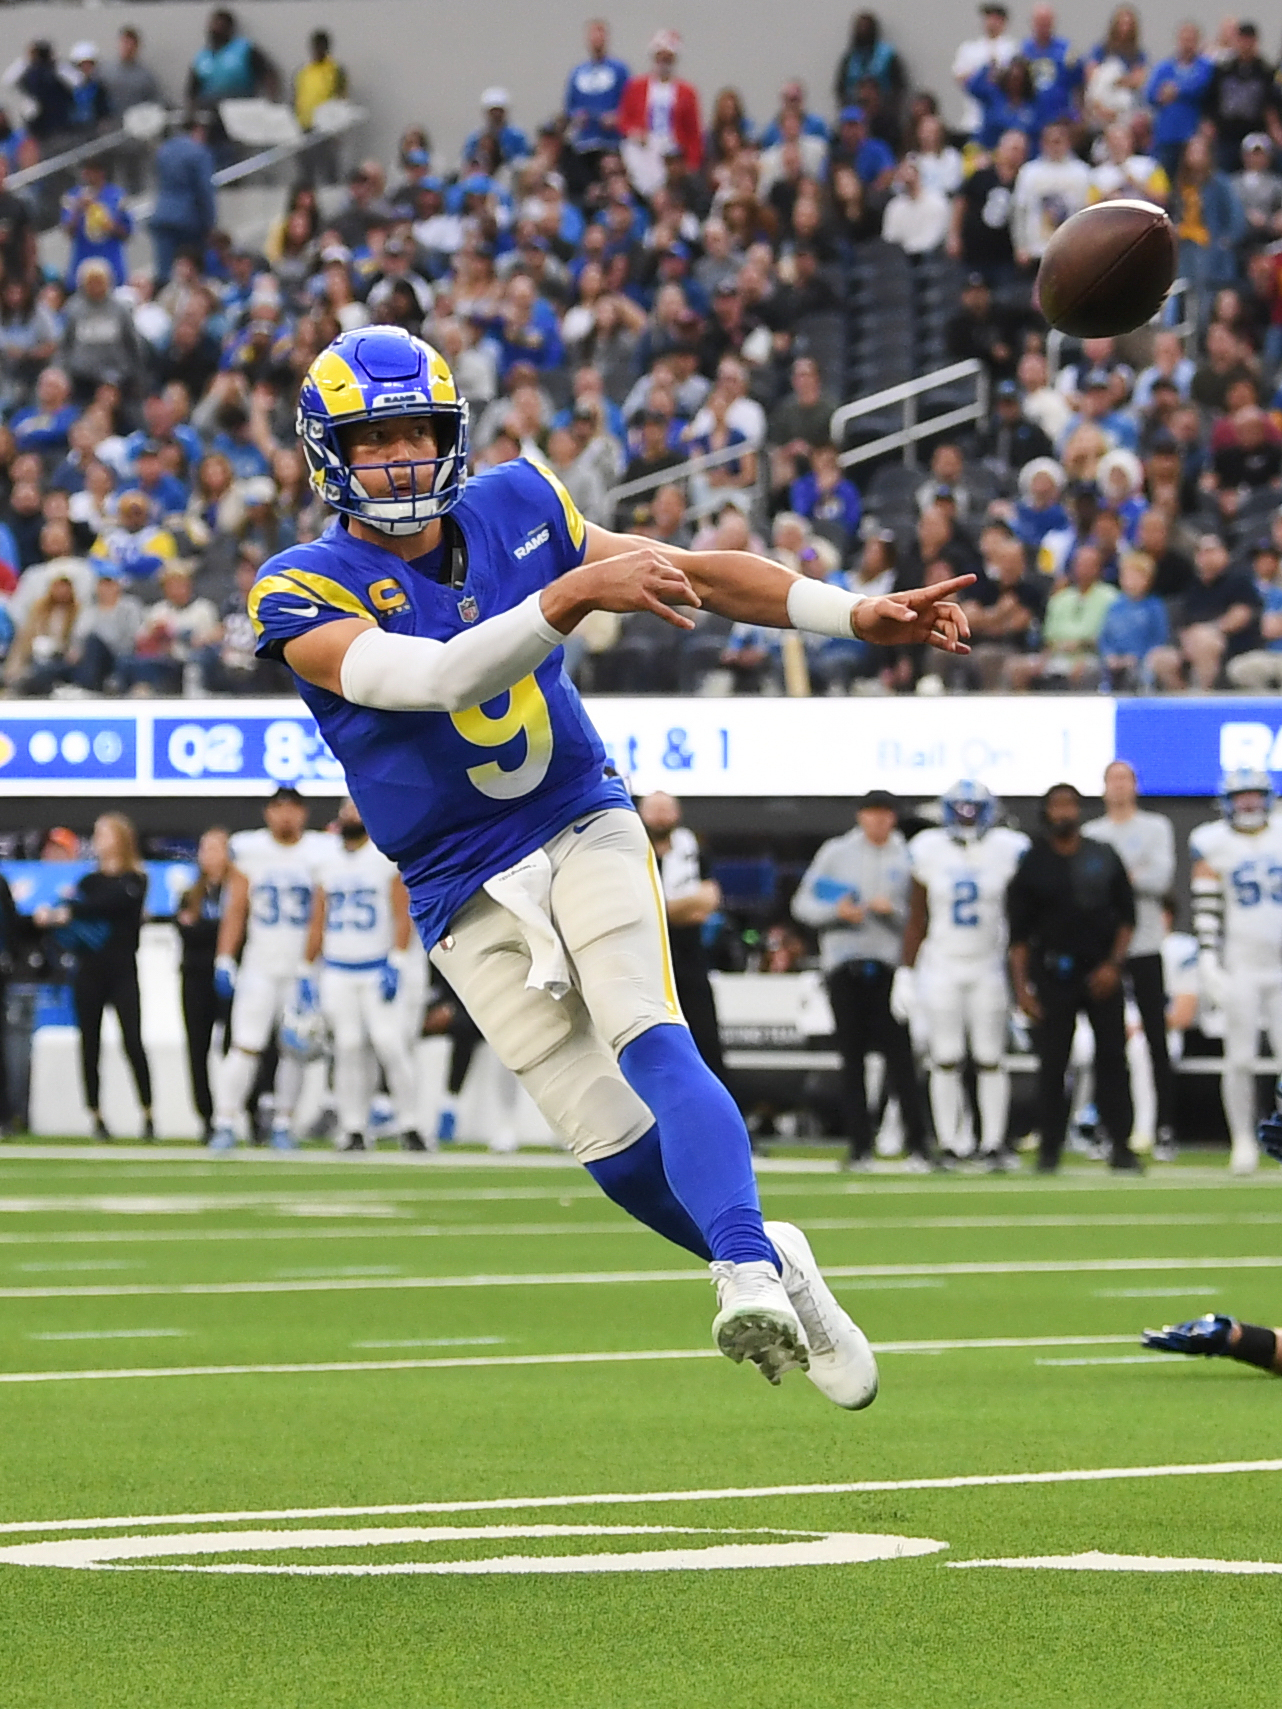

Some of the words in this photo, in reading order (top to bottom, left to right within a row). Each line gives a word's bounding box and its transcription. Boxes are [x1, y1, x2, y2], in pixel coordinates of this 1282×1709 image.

[384, 394, 417, 403] RAMS
[513, 529, 550, 560] RAMS
[368, 577, 407, 611] C
[449, 671, 554, 800] 9
[662, 727, 694, 770] &
[256, 884, 312, 926] 33
[327, 887, 377, 931] 25
[952, 880, 979, 927] 2
